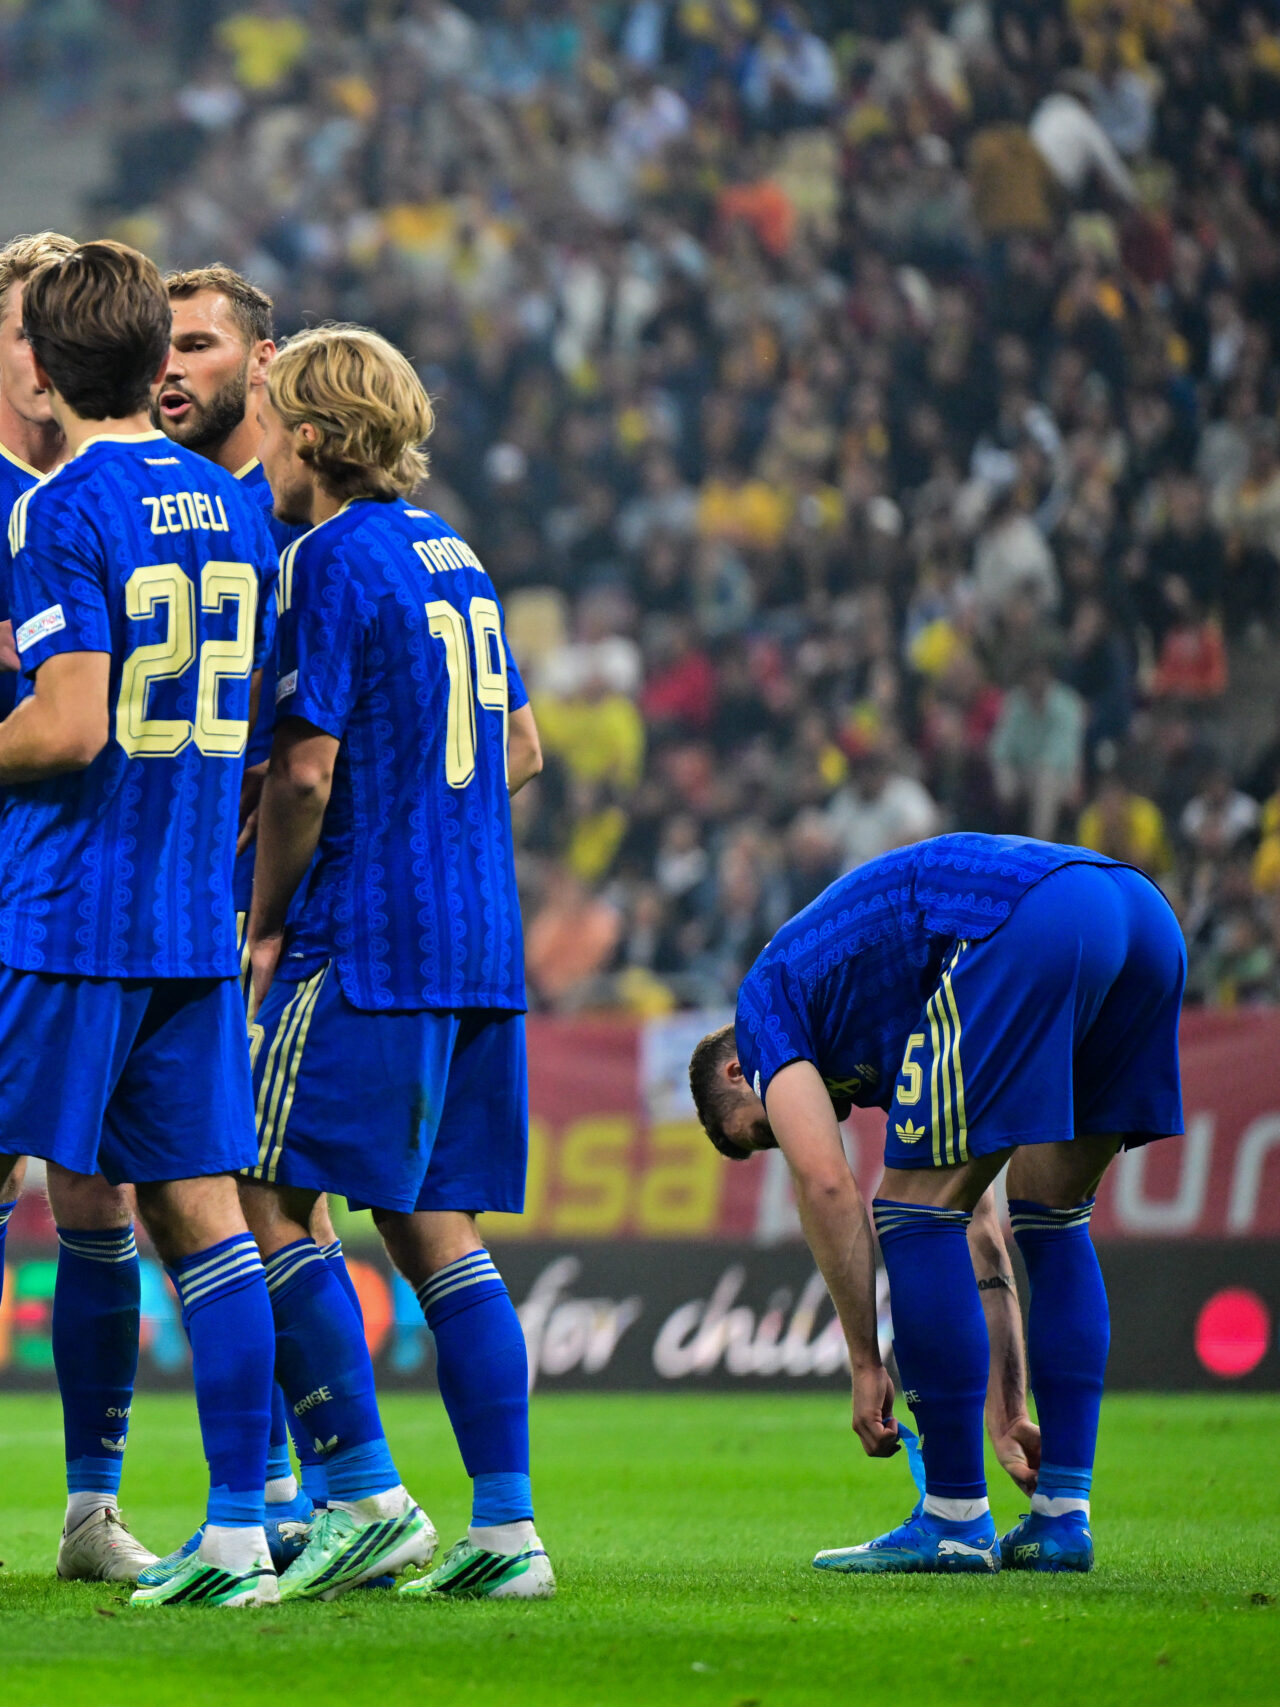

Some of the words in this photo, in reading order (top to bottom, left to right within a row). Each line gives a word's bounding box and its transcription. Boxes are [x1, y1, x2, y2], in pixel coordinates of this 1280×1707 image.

[141, 491, 230, 535] ZENELI
[115, 560, 259, 760] 22
[424, 596, 510, 790] 19
[896, 1032, 926, 1106] 5
[293, 1385, 334, 1417] ERIGE
